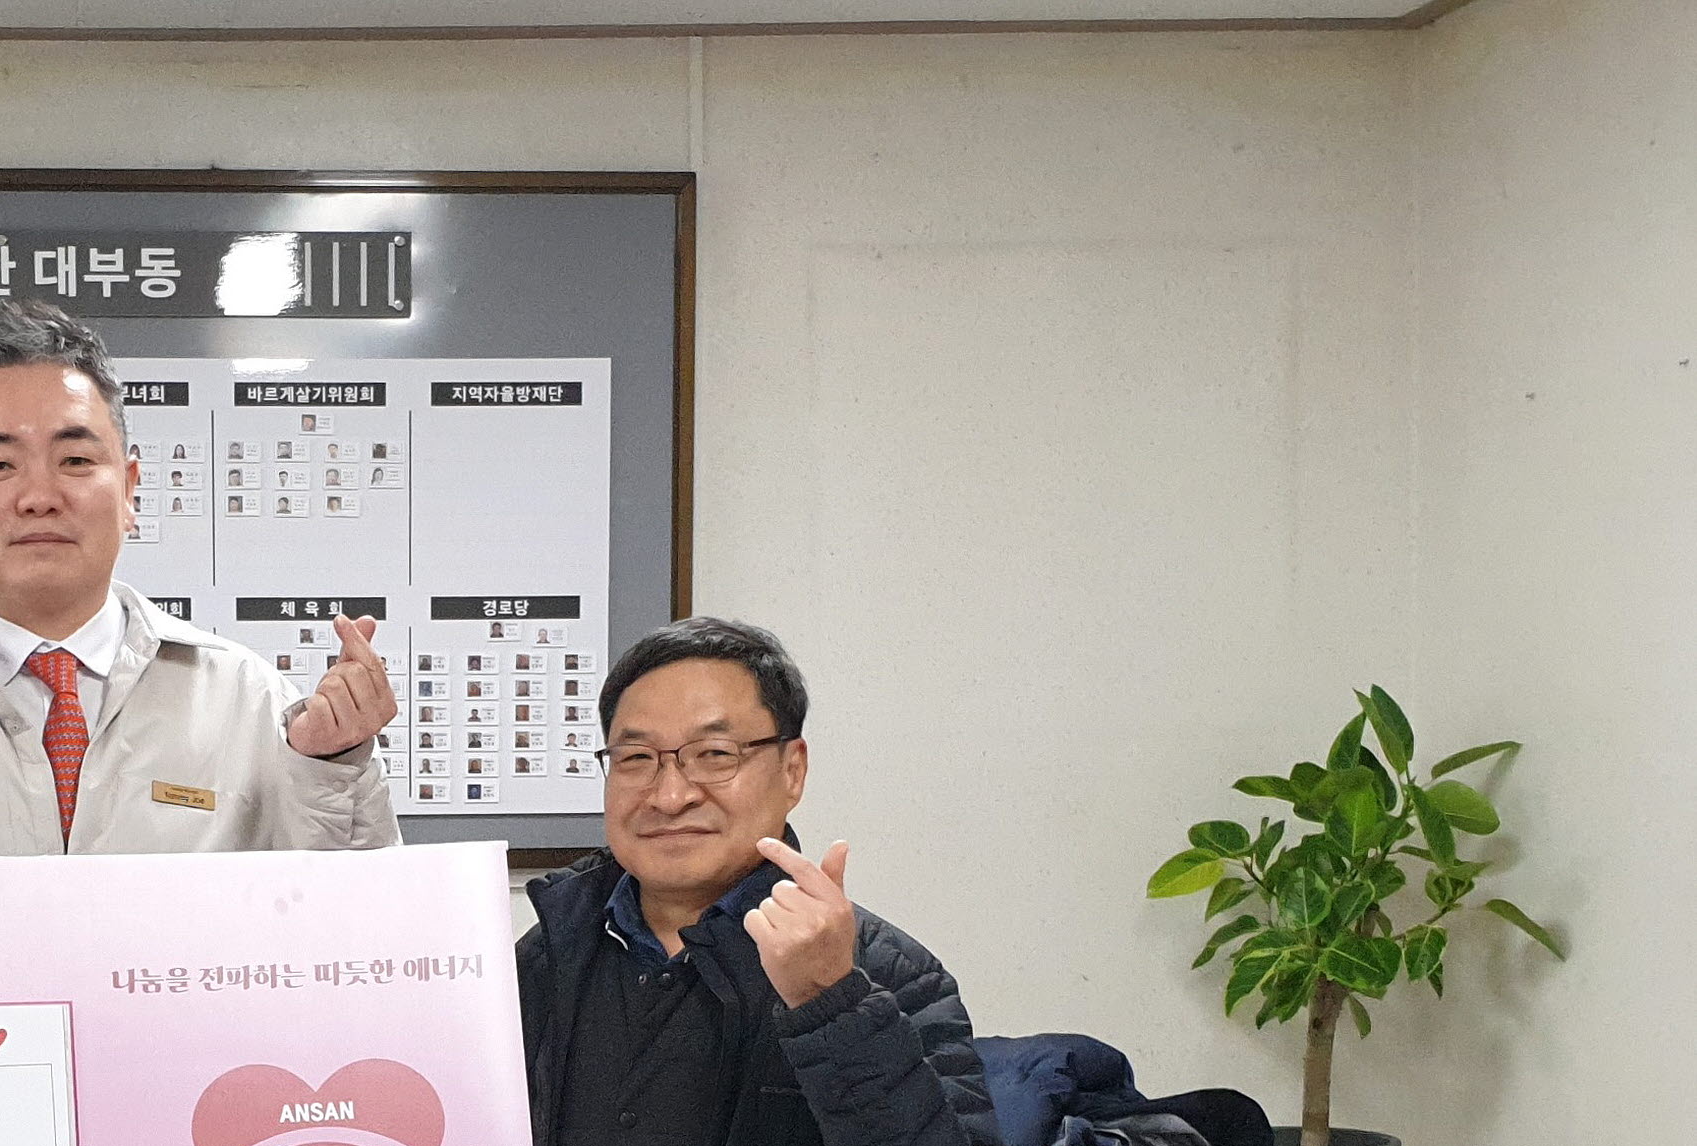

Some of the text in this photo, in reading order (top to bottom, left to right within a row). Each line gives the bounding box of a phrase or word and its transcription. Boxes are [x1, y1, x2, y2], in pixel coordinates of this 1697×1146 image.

[34, 245, 182, 298] 대부동
[247, 386, 375, 403] 바르게살기위원회
[452, 385, 564, 403] 지역자율방재단
[482, 600, 530, 617] 경로당
[113, 967, 191, 994] 나눔을
[198, 963, 306, 992] 전파하는
[278, 1100, 355, 1124] ANSAN
